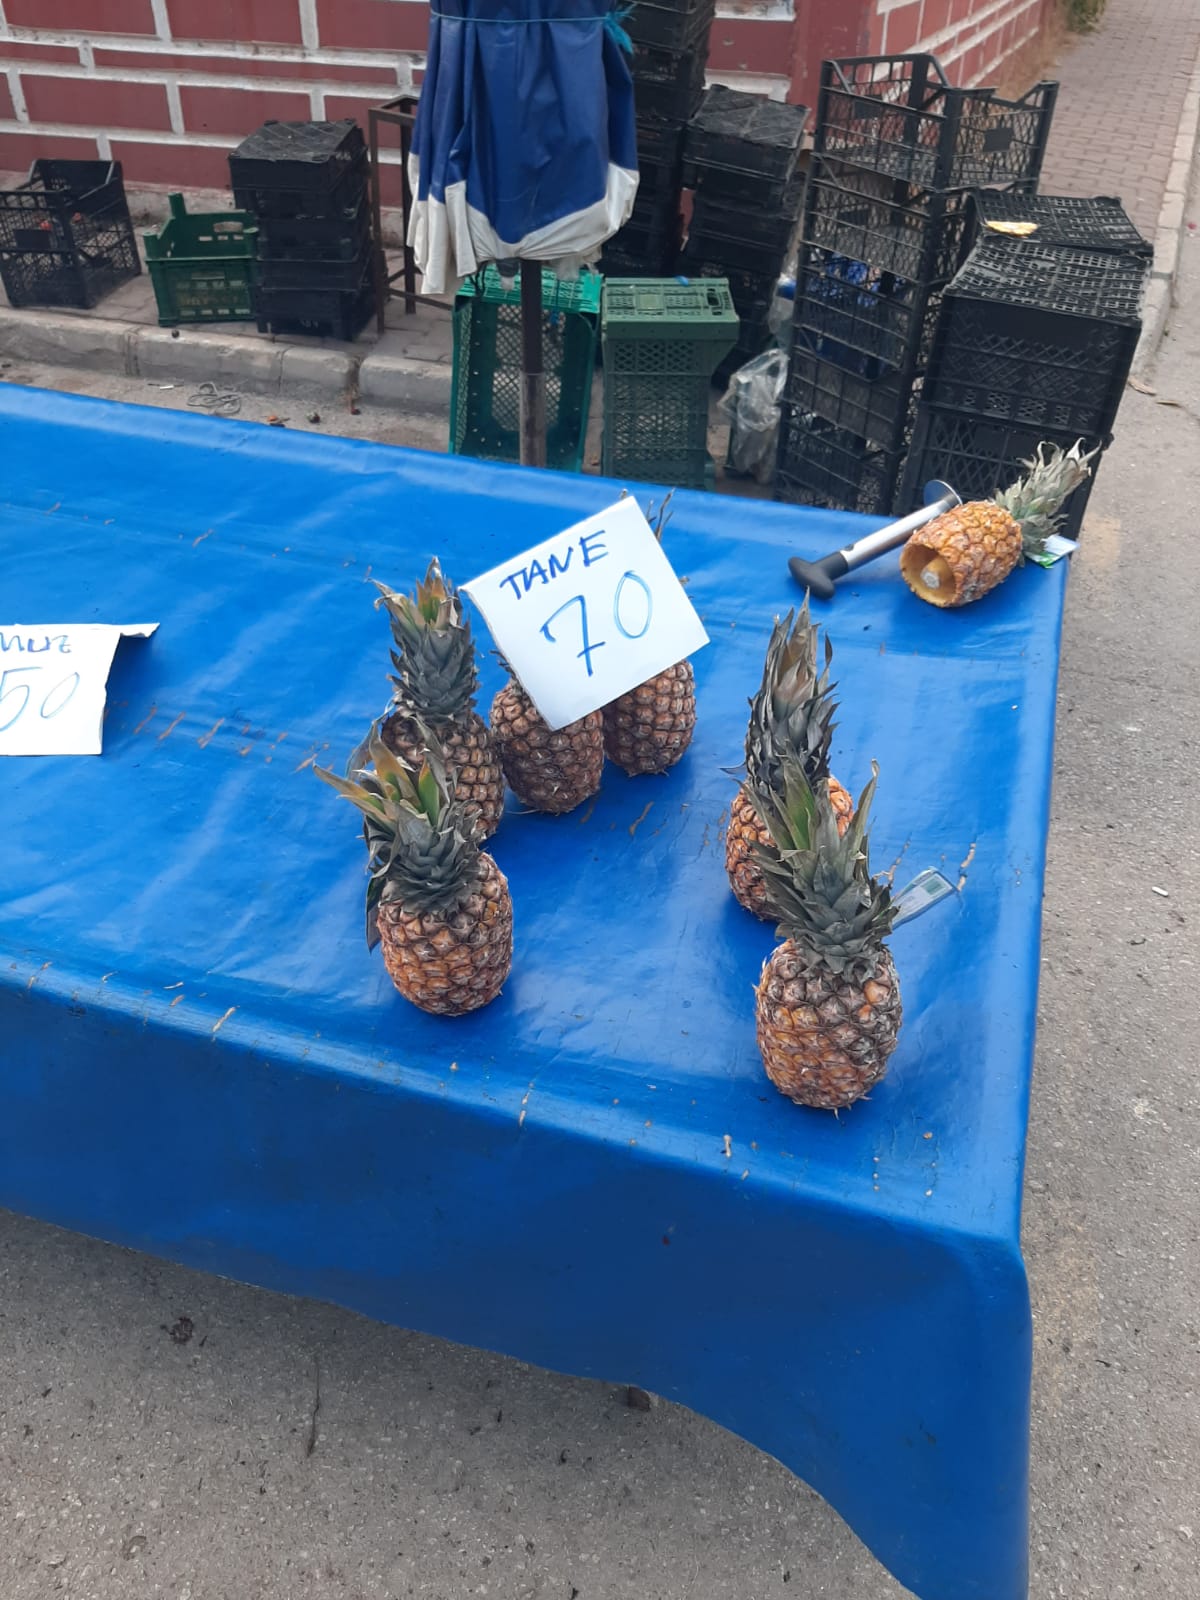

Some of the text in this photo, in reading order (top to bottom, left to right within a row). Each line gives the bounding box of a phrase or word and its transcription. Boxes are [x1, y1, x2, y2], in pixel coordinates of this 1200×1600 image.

[500, 529, 609, 600] TANE
[540, 570, 653, 676] 70
[0, 666, 80, 732] 50
